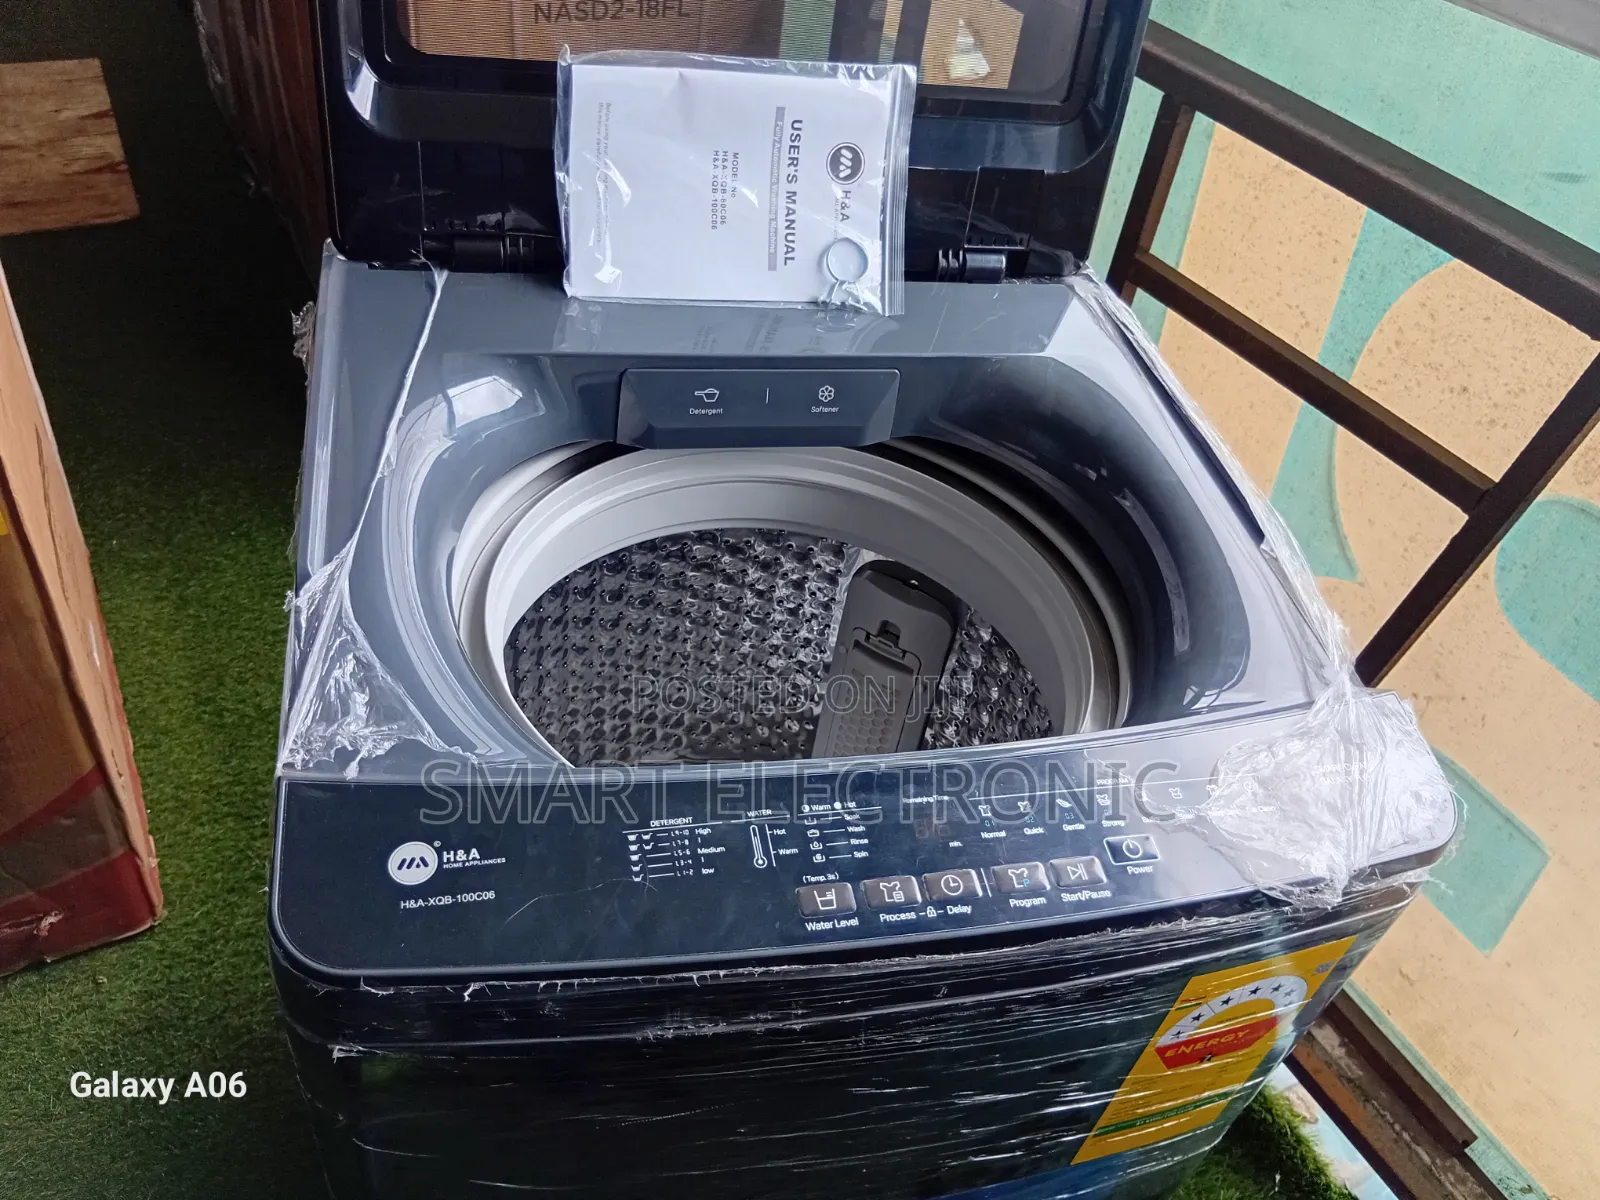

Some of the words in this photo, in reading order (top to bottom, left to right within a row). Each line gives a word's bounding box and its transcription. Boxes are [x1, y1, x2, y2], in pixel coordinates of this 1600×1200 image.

[773, 121, 783, 141] Fully
[786, 119, 803, 185] USER'S
[771, 142, 781, 183] Automatic
[769, 183, 778, 219] Washing
[840, 190, 852, 222] H&A
[783, 190, 798, 266] MANUAL
[769, 219, 777, 253] Machine
[689, 407, 723, 416] Detergent
[810, 405, 839, 413] Softener
[811, 802, 831, 811] Warm
[844, 801, 857, 809] Hot
[747, 809, 772, 818] WATER
[650, 816, 693, 827] DETERGENT
[1102, 820, 1125, 829] Strong
[695, 828, 712, 837] High
[773, 828, 787, 836] Hot
[847, 825, 866, 833] Wash
[1023, 827, 1045, 835] Quick
[1062, 823, 1086, 832] Gentle
[981, 830, 1007, 839] Normal
[850, 837, 869, 845] Rinse
[443, 848, 481, 863] H&A
[698, 846, 726, 855] Medium
[778, 848, 799, 856] Warm
[853, 851, 869, 859] Spin
[464, 857, 506, 868] APPLIANCES
[1127, 865, 1154, 875] Power
[400, 890, 496, 909] H&A-XQB-100C06
[1061, 889, 1111, 903] Start/Pause
[1009, 897, 1047, 909] Program
[946, 905, 972, 916] Delay
[879, 911, 917, 923] Process
[805, 921, 833, 932] Water
[834, 917, 860, 929] Level
[1163, 1029, 1251, 1058] ENERGY
